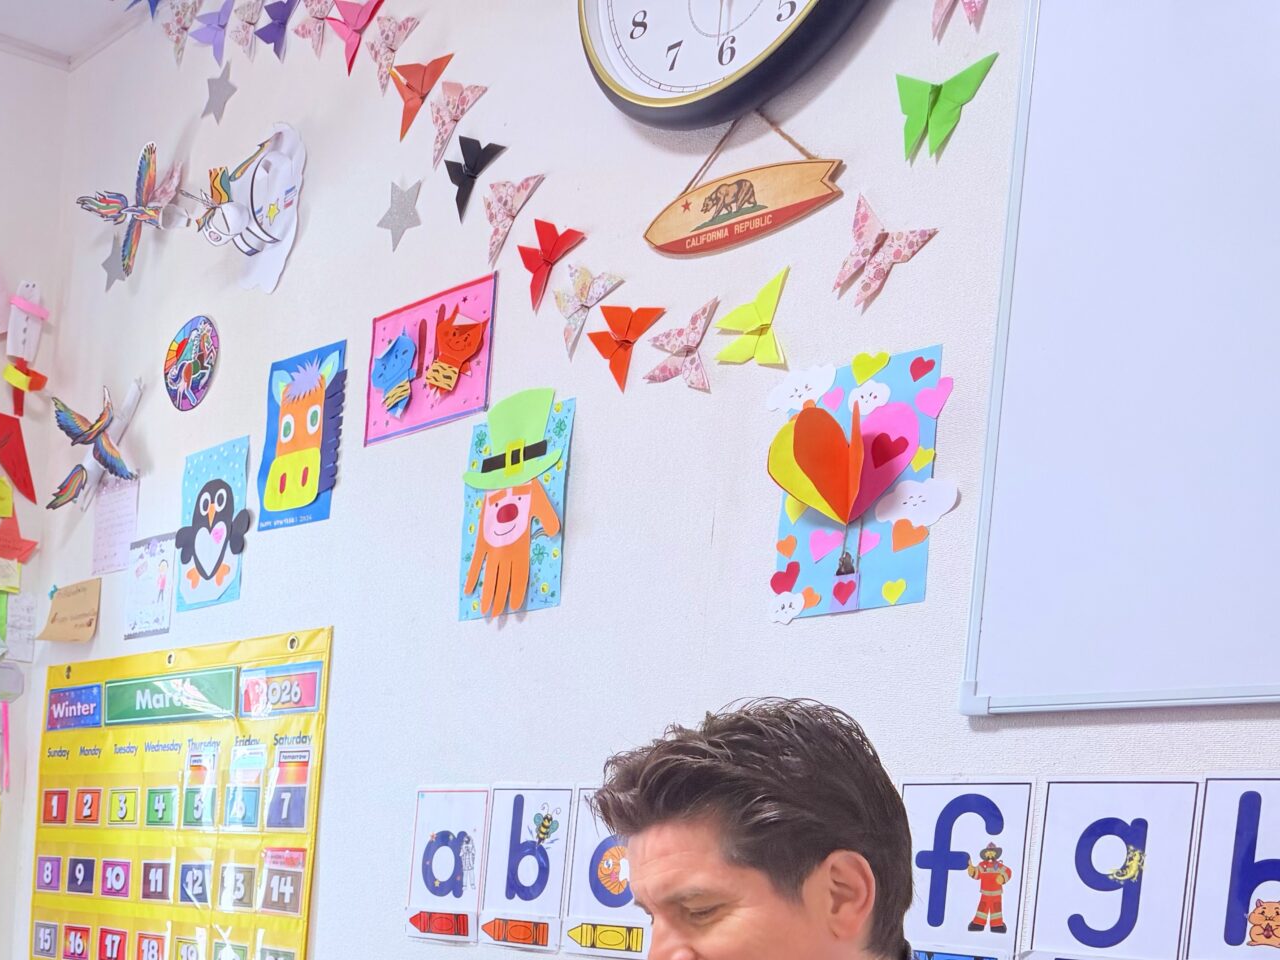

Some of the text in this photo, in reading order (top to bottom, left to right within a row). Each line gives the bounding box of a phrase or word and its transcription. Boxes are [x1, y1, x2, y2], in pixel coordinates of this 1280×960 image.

[630, 10, 648, 40] 8
[776, 0, 797, 22] 5
[665, 40, 684, 71] 7
[717, 35, 737, 66] 6
[685, 214, 773, 249] CALIFORNIA REPUBLIC
[51, 700, 96, 718] Winter
[48, 746, 70, 760] Sunday
[79, 745, 102, 759] Monday
[114, 743, 138, 756] Tuesday
[145, 740, 183, 754] Wednesday
[188, 737, 221, 751] Thursday
[273, 732, 312, 747] Saturday
[51, 796, 58, 817] 1
[83, 795, 93, 817] 2
[118, 795, 127, 819] 3
[154, 796, 165, 819] 4
[193, 792, 204, 819] 5
[280, 792, 292, 819] 7
[505, 793, 550, 902] b
[915, 793, 1005, 928] f
[422, 830, 468, 899] a
[42, 864, 52, 884] 8
[75, 863, 84, 884] 9
[105, 867, 125, 890] 10
[149, 869, 163, 892] 11
[186, 868, 203, 895] 12
[270, 875, 294, 903] 14
[1067, 816, 1150, 949] g
[38, 928, 51, 950] 15
[69, 932, 83, 954] 16
[105, 934, 120, 959] 17
